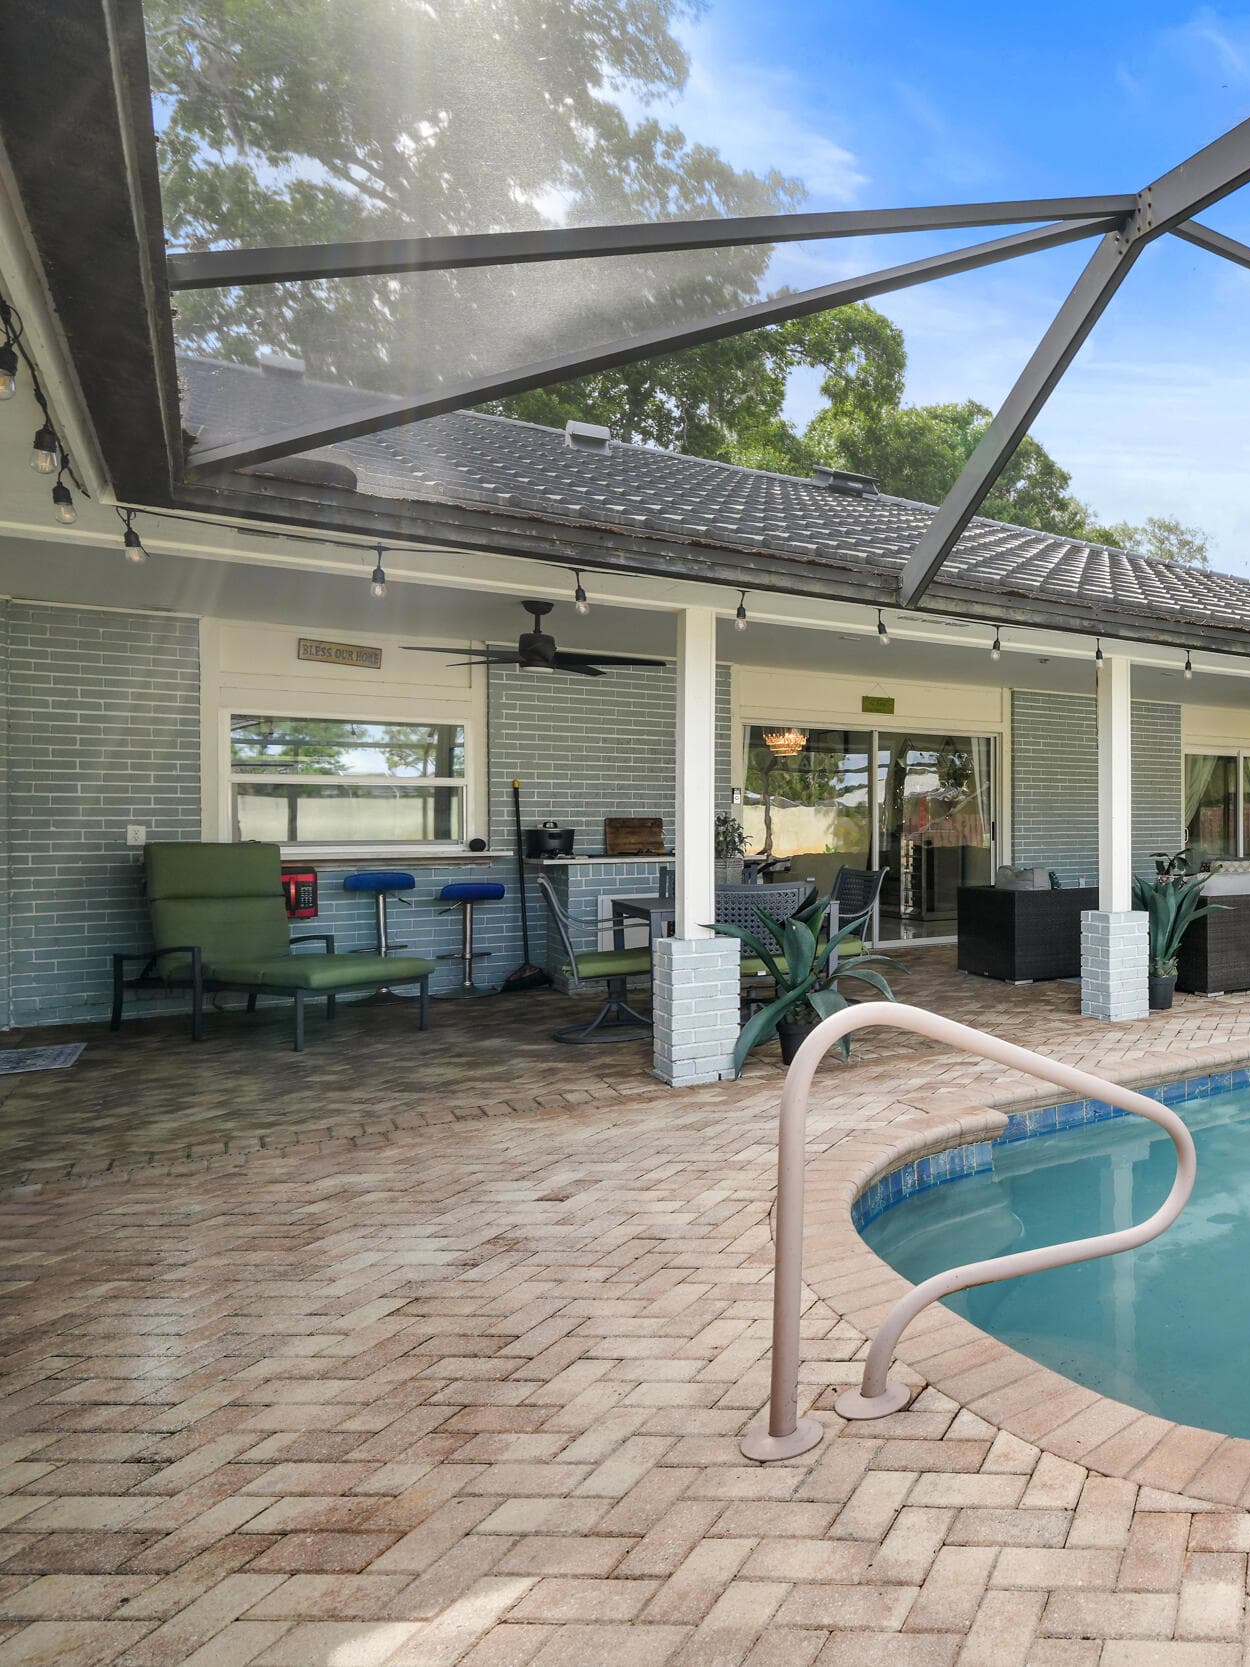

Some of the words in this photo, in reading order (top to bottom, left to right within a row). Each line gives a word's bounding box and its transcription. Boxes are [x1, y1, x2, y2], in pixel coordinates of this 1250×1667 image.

[302, 643, 333, 658] BLESS
[335, 648, 354, 661] OUR
[356, 651, 379, 665] HOME
